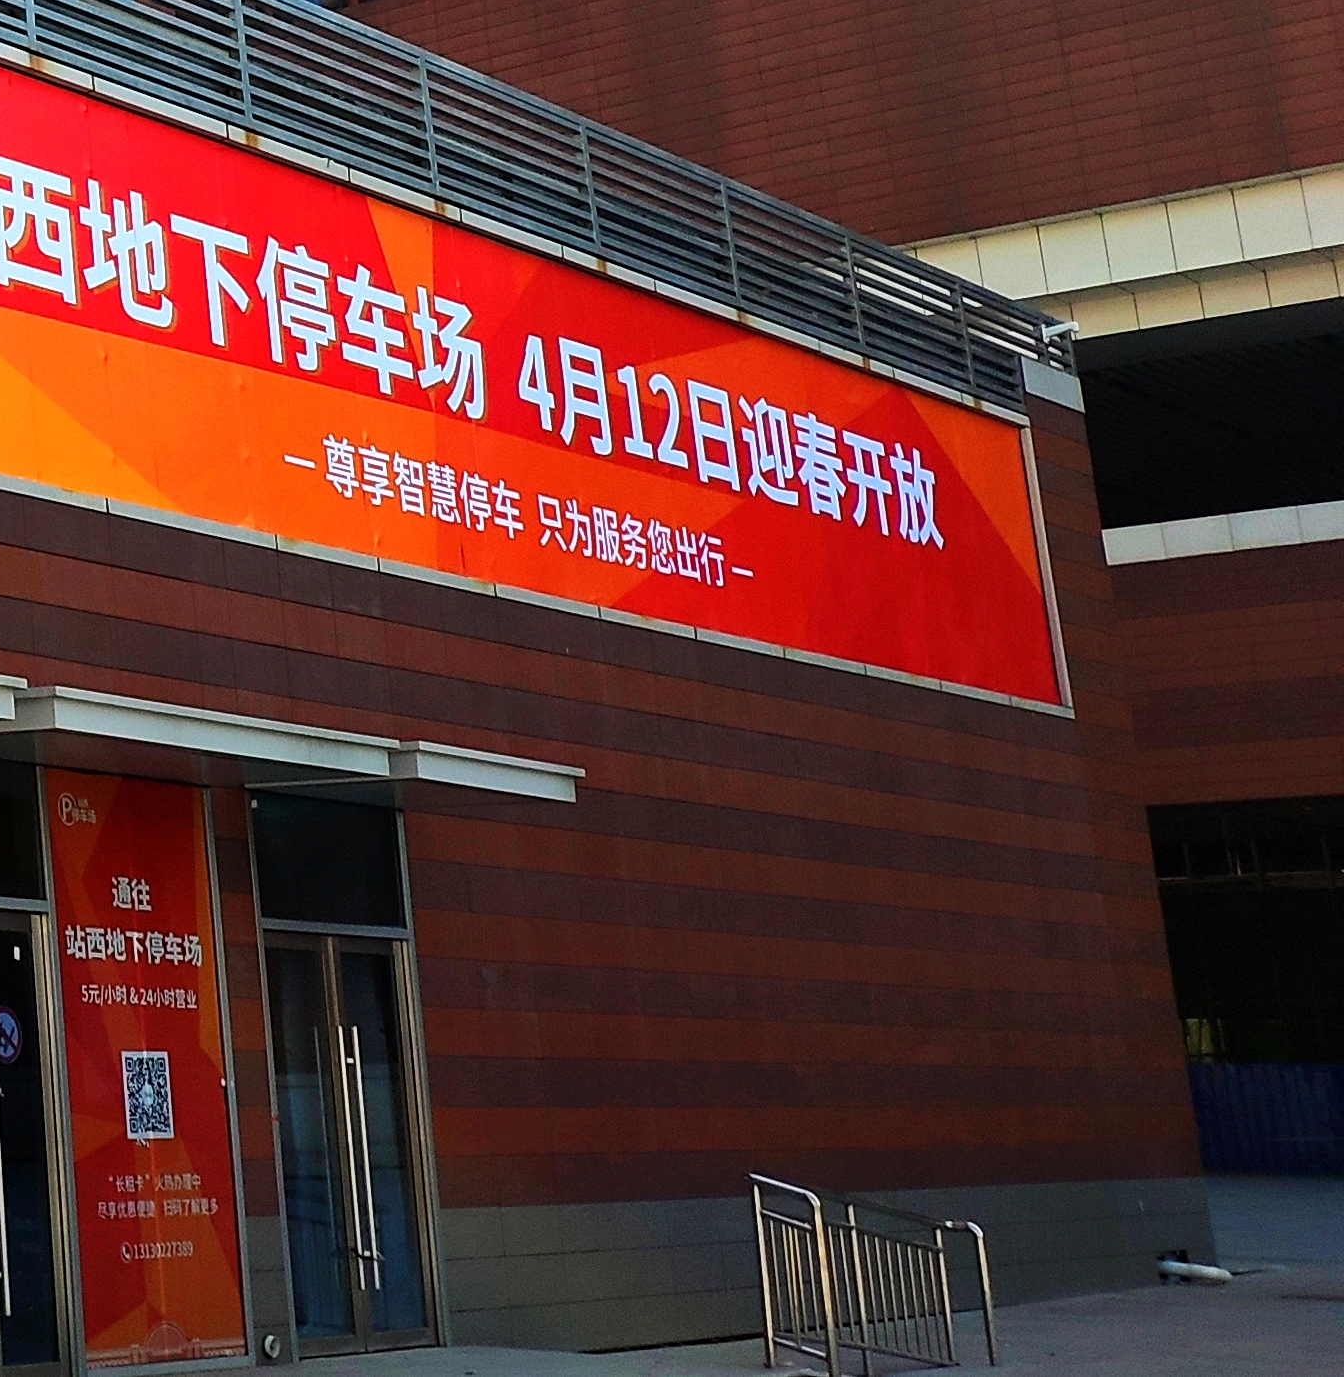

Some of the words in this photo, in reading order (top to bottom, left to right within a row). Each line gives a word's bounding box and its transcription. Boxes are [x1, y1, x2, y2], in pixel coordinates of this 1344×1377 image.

[519, 334, 946, 551] 4月12日迎春开放
[112, 877, 153, 911] 通往
[65, 925, 203, 967] 站西地下停车场
[81, 984, 127, 1007] 5元/小时
[129, 986, 139, 1004] &
[140, 988, 198, 1009] 24小时营业
